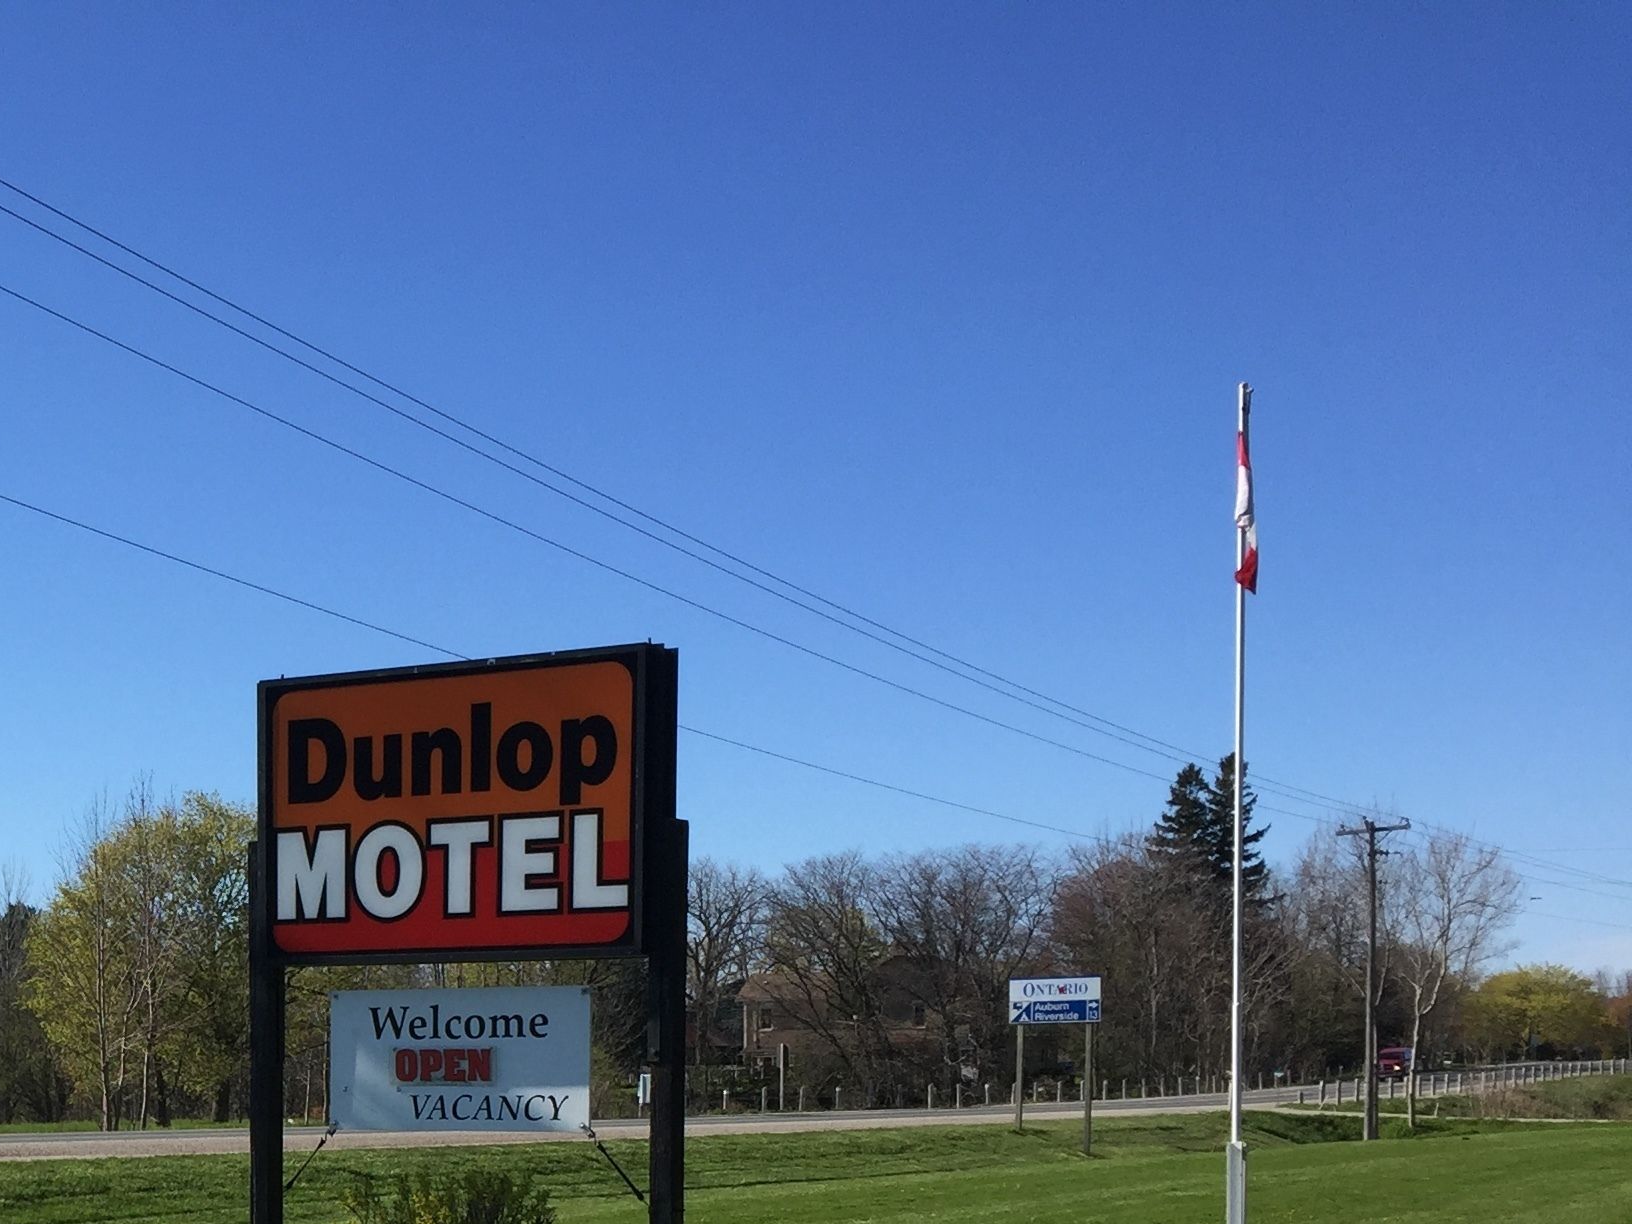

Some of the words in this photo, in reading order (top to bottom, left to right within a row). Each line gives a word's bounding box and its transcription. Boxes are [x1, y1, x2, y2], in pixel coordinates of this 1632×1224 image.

[287, 702, 617, 805] Dunlop
[276, 808, 629, 922] MOTEL
[1034, 1002, 1070, 1010] Auburn
[1034, 1012, 1079, 1020] Riverside
[369, 1005, 549, 1041] Welcome
[395, 1049, 493, 1082] OPEN
[410, 1094, 569, 1122] VACANCY
